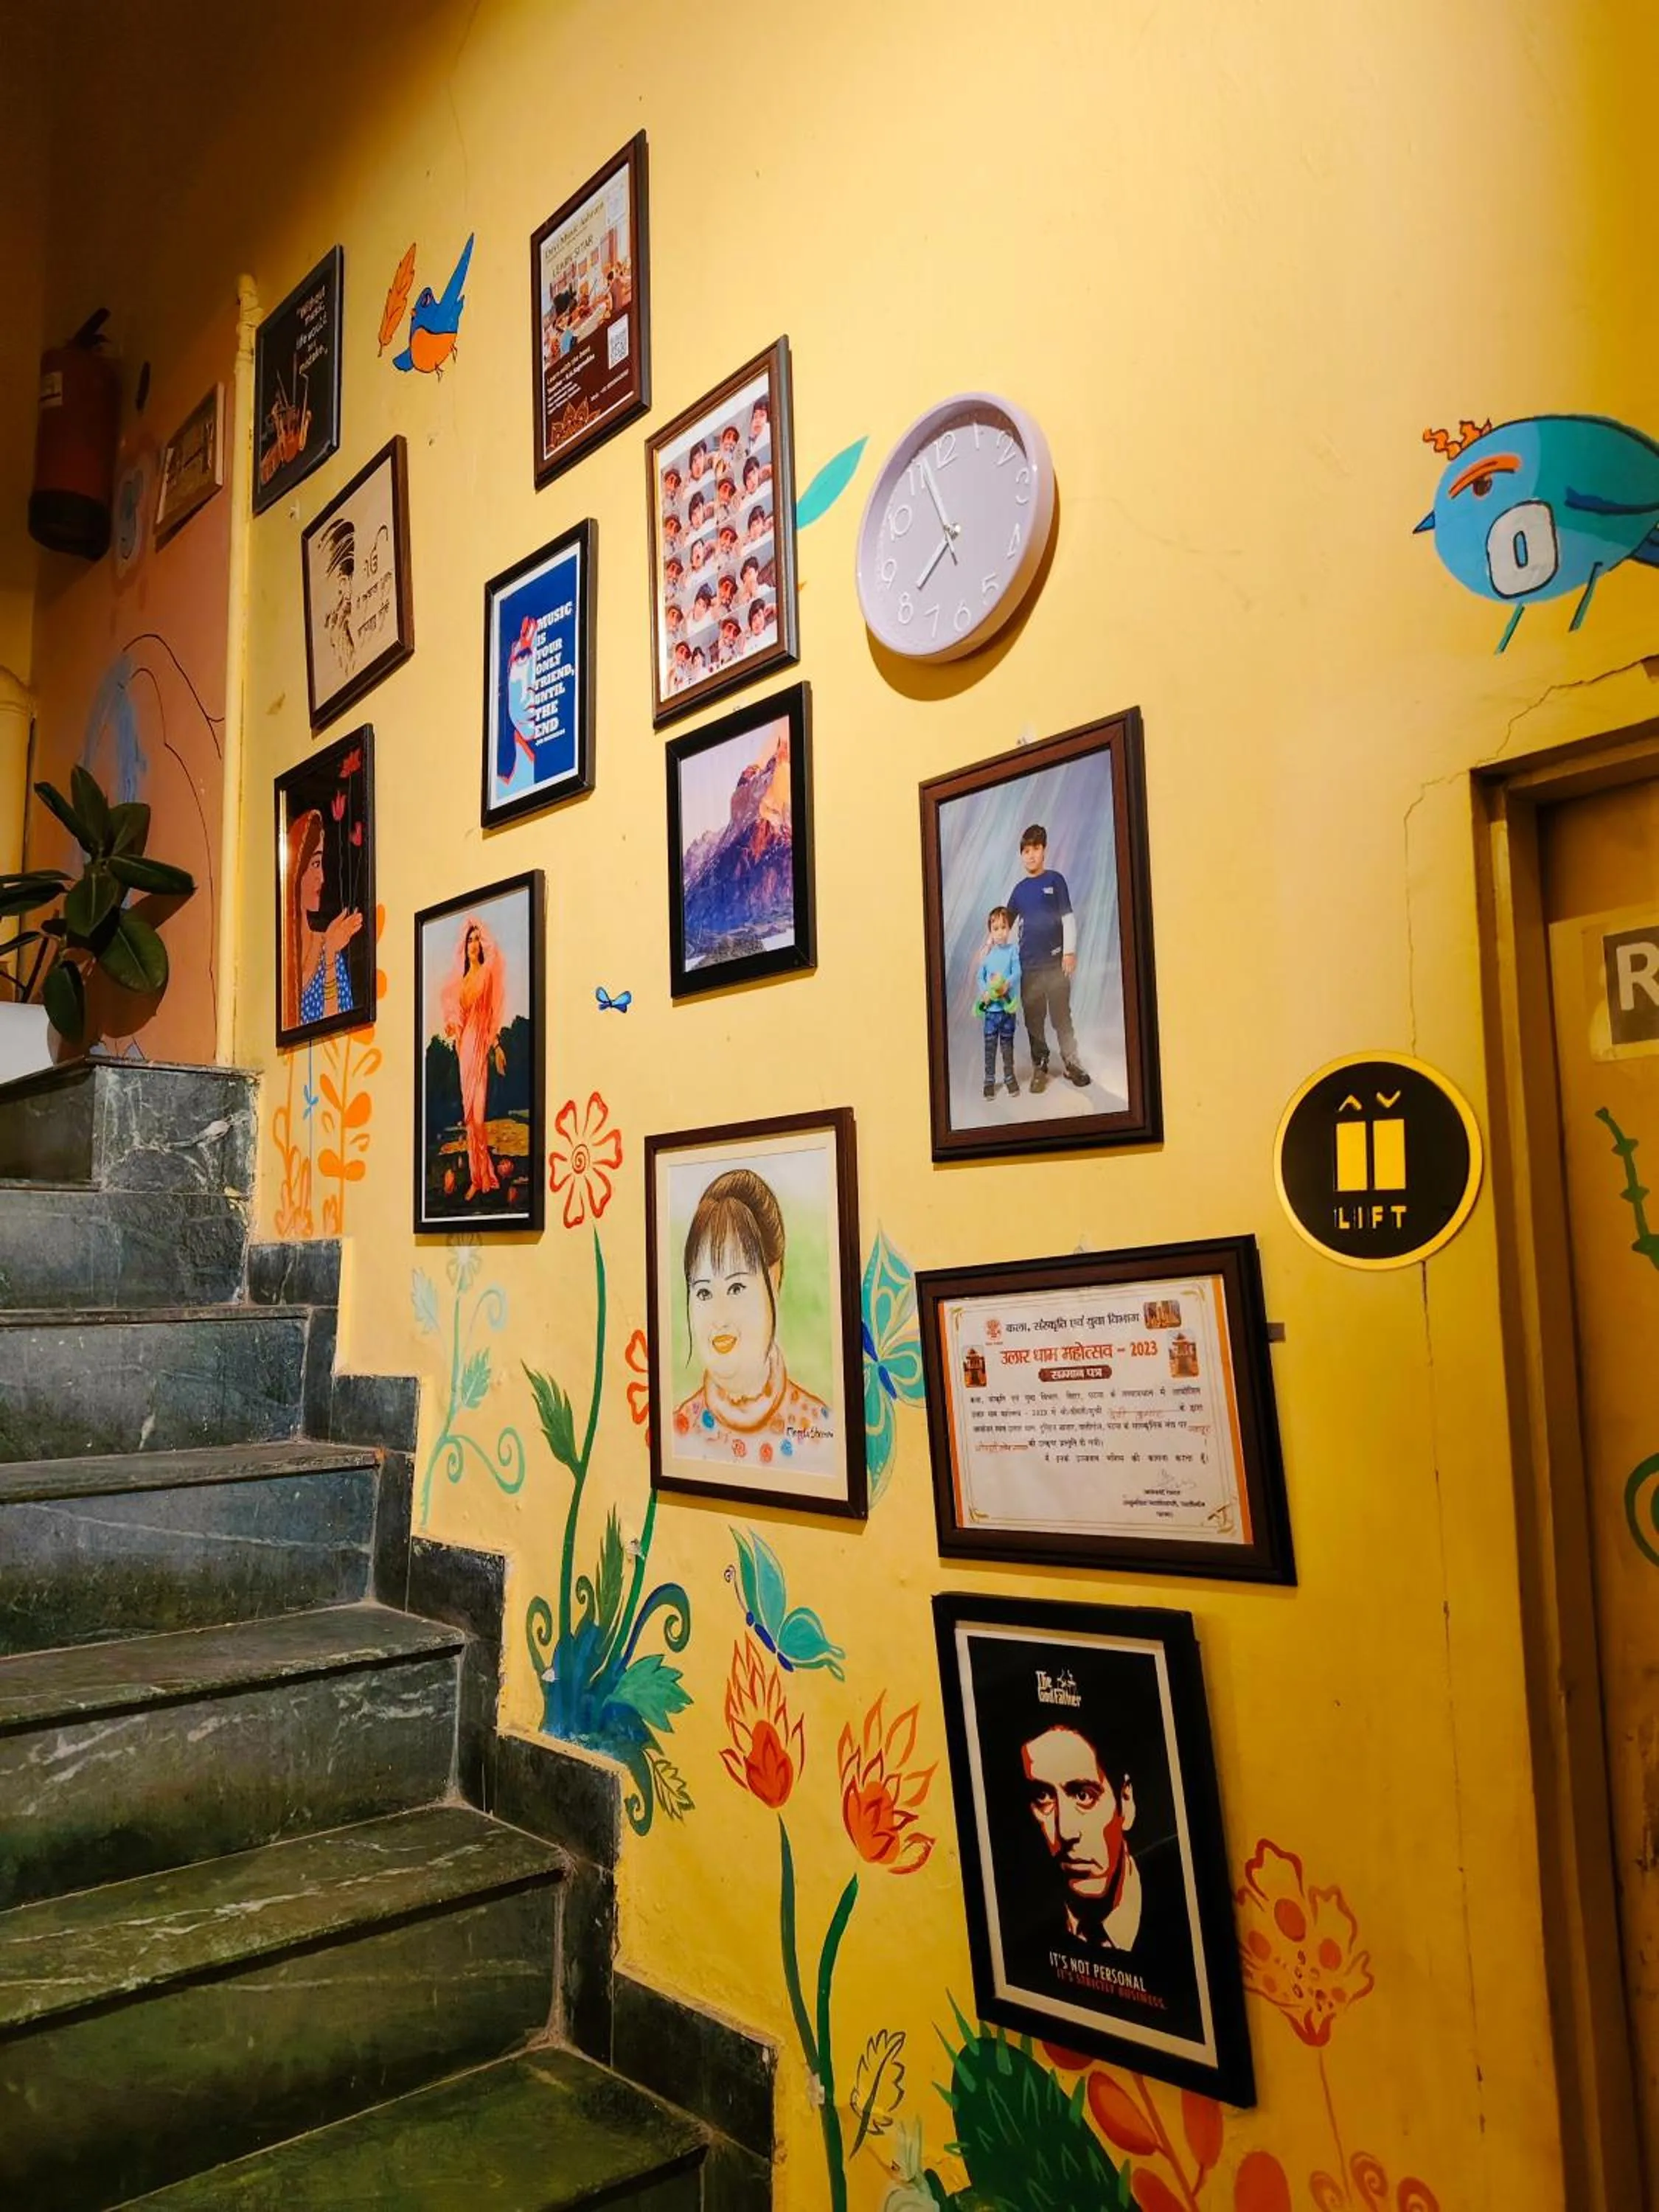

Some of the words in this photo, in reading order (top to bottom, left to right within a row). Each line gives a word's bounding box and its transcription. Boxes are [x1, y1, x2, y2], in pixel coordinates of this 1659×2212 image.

[973, 422, 979, 449] 1
[996, 430, 1016, 467] 2
[933, 431, 957, 470] 12
[906, 459, 926, 495] 11
[1015, 467, 1030, 506] 3
[887, 504, 913, 541] 10
[1007, 523, 1020, 560] 4
[881, 558, 897, 590] 9
[982, 572, 999, 605] 5
[537, 601, 573, 632] MUSIC
[897, 592, 914, 625] 8
[925, 604, 939, 638] 7
[954, 601, 971, 632] 6
[536, 637, 563, 661] YOUR
[537, 632, 546, 647] IS
[534, 663, 574, 691] FRIEND,
[536, 653, 561, 675] ONLY
[535, 681, 566, 705] UNTIL
[535, 698, 558, 722] THE
[534, 717, 559, 738] END
[1338, 1206, 1407, 1230] LIFT
[1032, 1316, 1067, 1332] संस्कृति
[1069, 1315, 1085, 1330] एवं
[1086, 1315, 1105, 1329] युवा
[1107, 1312, 1140, 1325] विभाग
[999, 1349, 1030, 1365] उलार
[1034, 1347, 1058, 1363] धाम
[1061, 1341, 1113, 1363] महोत्सव
[1130, 1340, 1158, 1357] 2023
[1050, 1368, 1085, 1380] सम्मान
[1086, 1367, 1103, 1379] पत्र
[1049, 1951, 1068, 1969] IT'S
[1070, 1957, 1091, 1977] NOT
[1093, 1963, 1147, 1992] PERSONAL
[1077, 1975, 1115, 1995] STRICTLY
